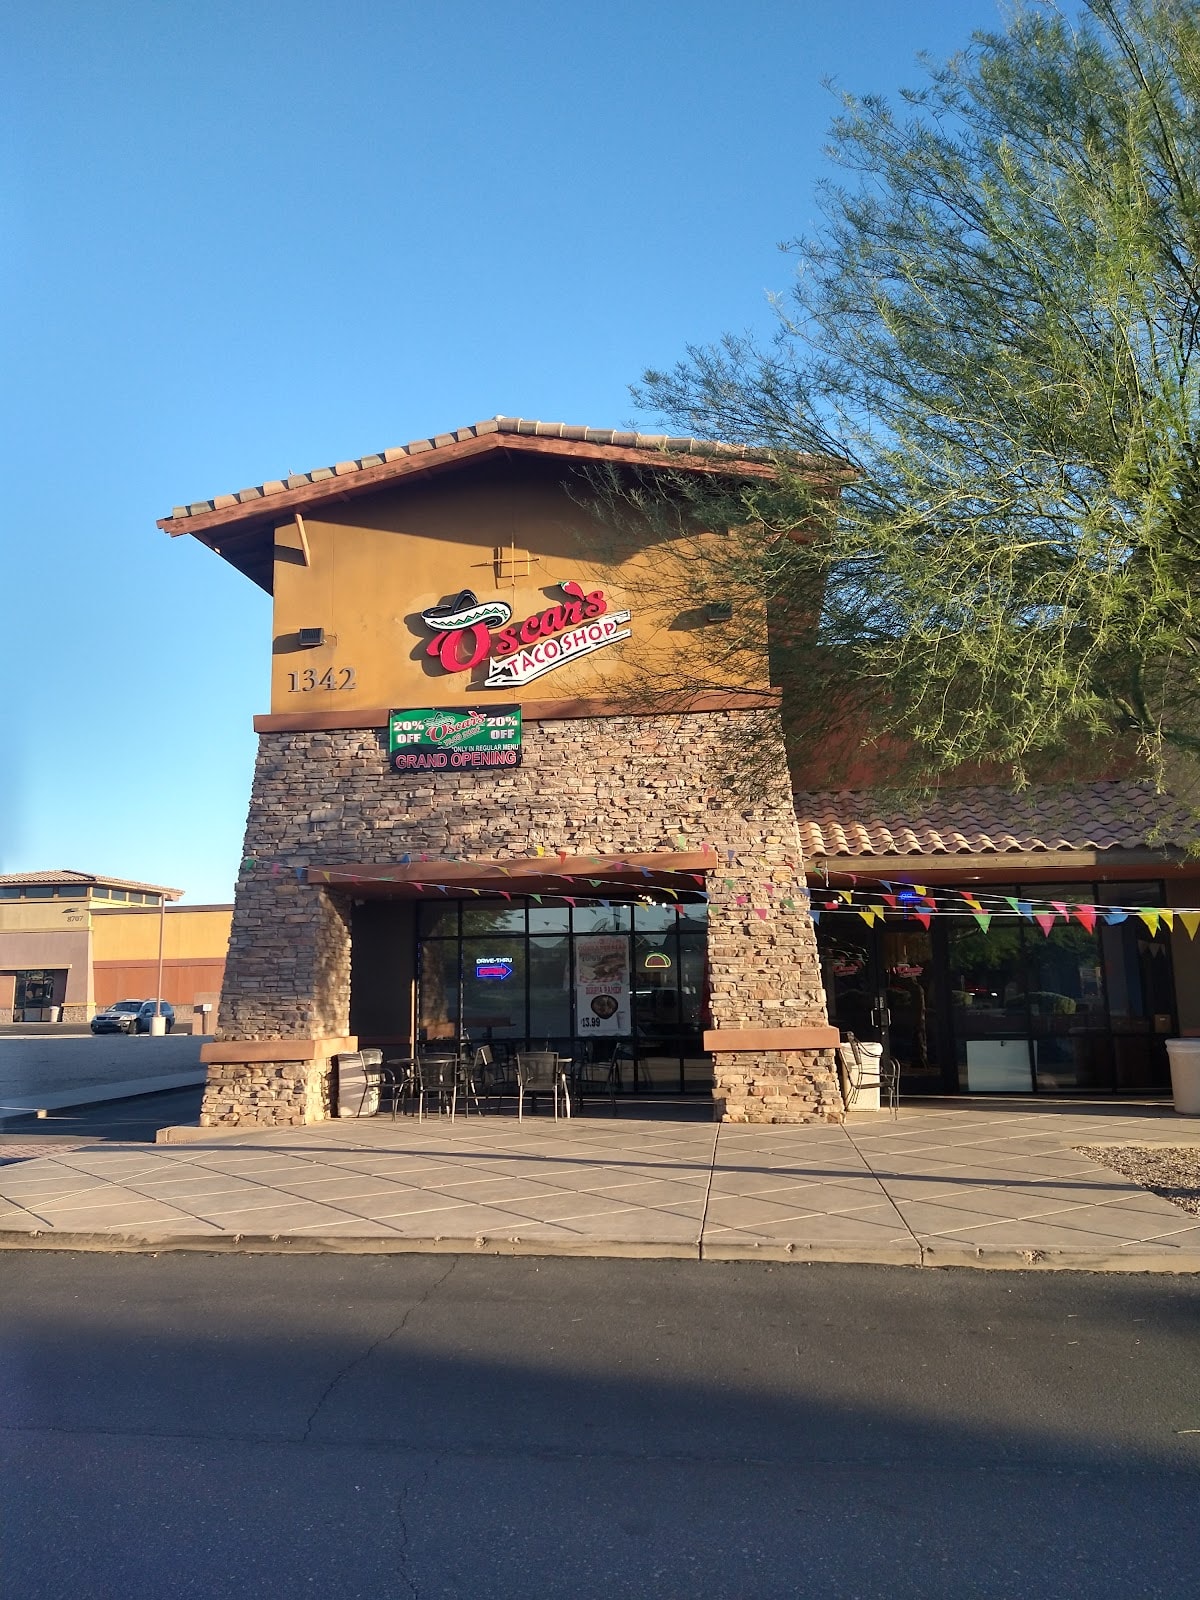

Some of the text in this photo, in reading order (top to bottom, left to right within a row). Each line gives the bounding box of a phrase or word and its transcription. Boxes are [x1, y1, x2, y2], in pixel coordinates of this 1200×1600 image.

[426, 581, 607, 672] Oscar's
[508, 621, 615, 676] TACO SHOP
[287, 667, 356, 693] 1342
[393, 720, 424, 731] 20%
[487, 716, 517, 727] 20%
[396, 733, 421, 744] OFF
[490, 729, 515, 740] OFF
[475, 744, 502, 752] REGULAR
[502, 743, 519, 751] MENU
[395, 751, 517, 769] GRAND OPENING
